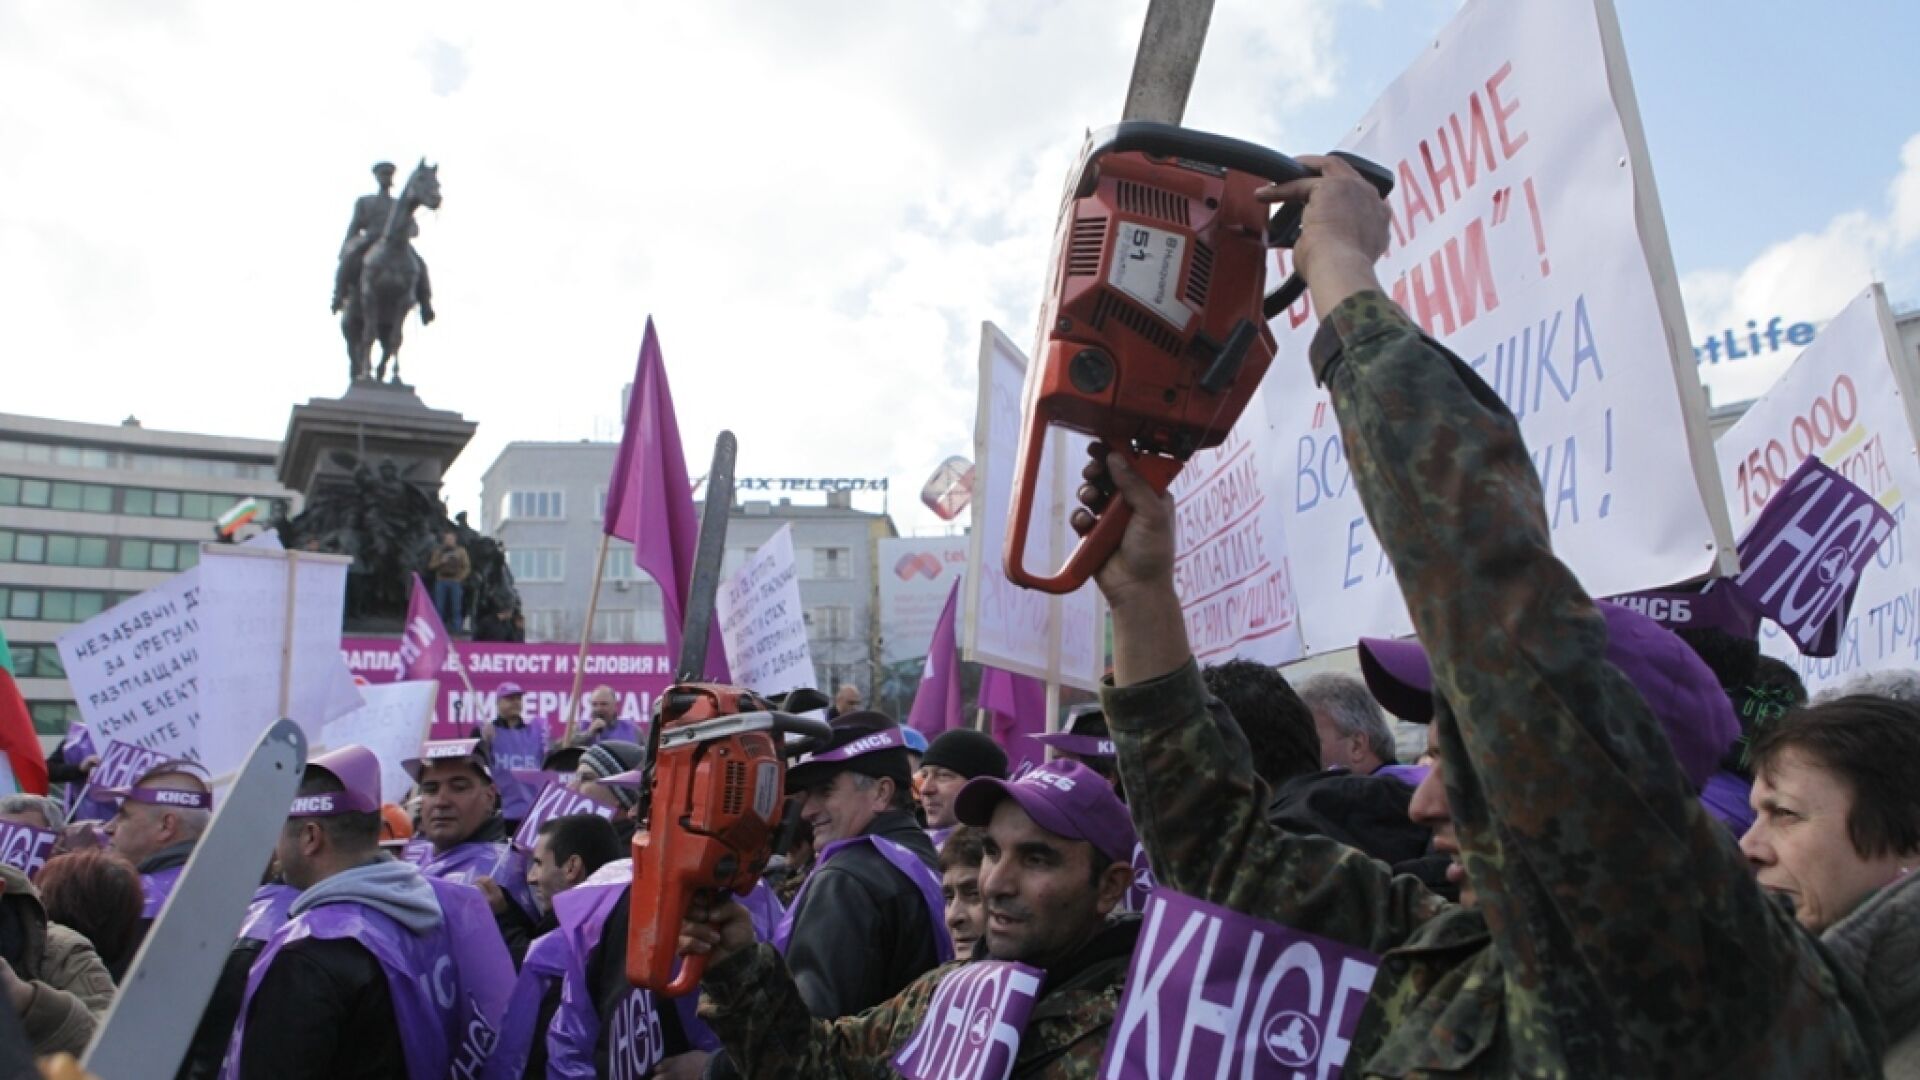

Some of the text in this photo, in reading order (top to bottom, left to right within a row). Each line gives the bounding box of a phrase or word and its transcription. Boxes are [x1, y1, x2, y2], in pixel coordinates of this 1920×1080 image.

[1130, 229, 1149, 261] 51
[1296, 434, 1349, 513] ВС
[1472, 293, 1605, 423] ШКА
[738, 477, 770, 491] AX
[1868, 588, 1920, 660] ТРУ
[469, 653, 551, 674] ЗАЕТОСТ
[555, 655, 569, 673] И
[141, 677, 199, 716] ЕЛЕКТ
[156, 790, 202, 806] КНСБ
